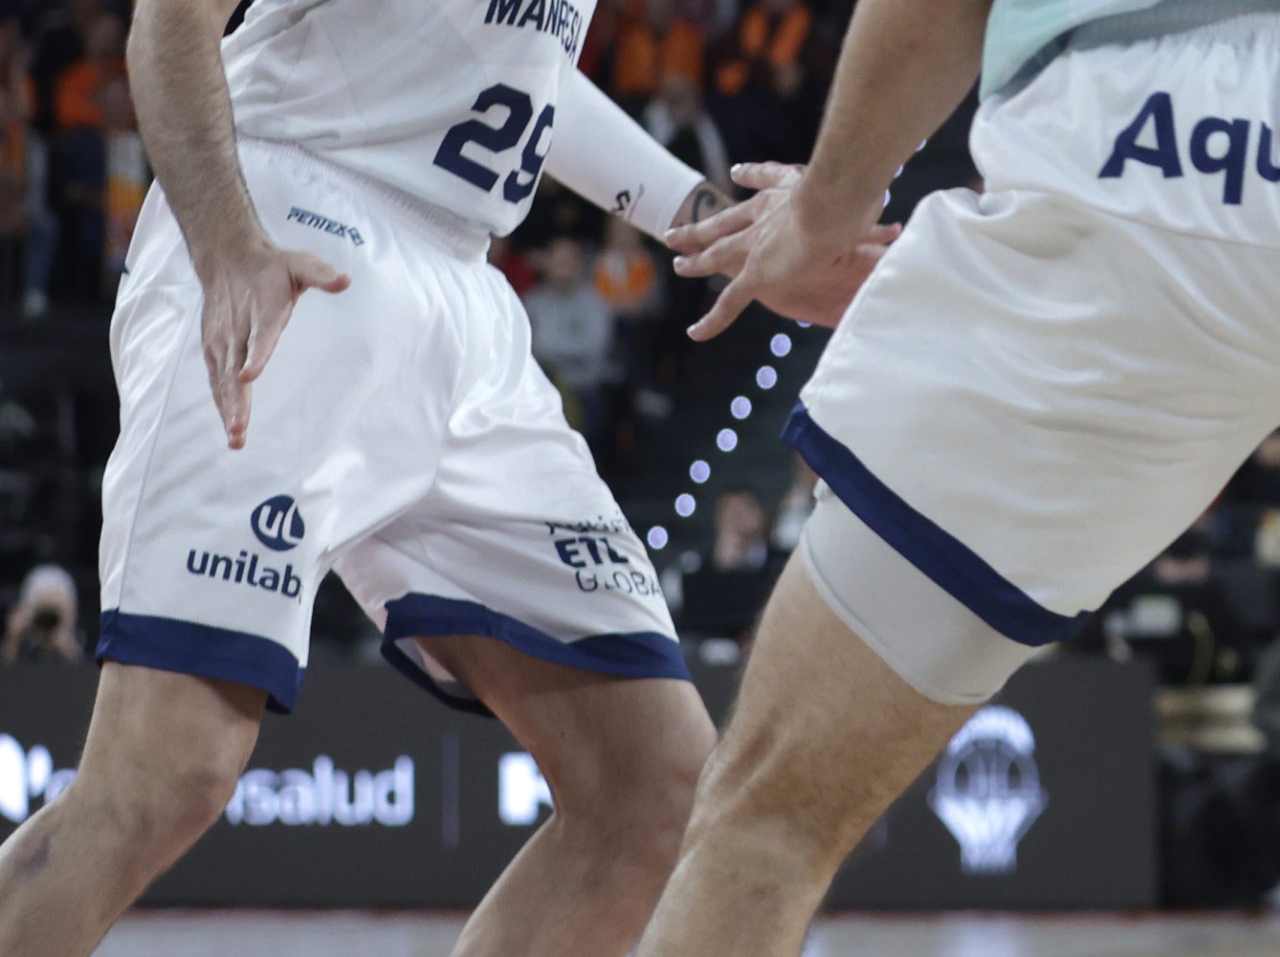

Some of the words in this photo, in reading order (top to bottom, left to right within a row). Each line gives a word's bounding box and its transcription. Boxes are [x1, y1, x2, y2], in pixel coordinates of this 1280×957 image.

[433, 82, 555, 204] 29
[186, 549, 303, 600] unilab
[555, 537, 629, 568] ETL
